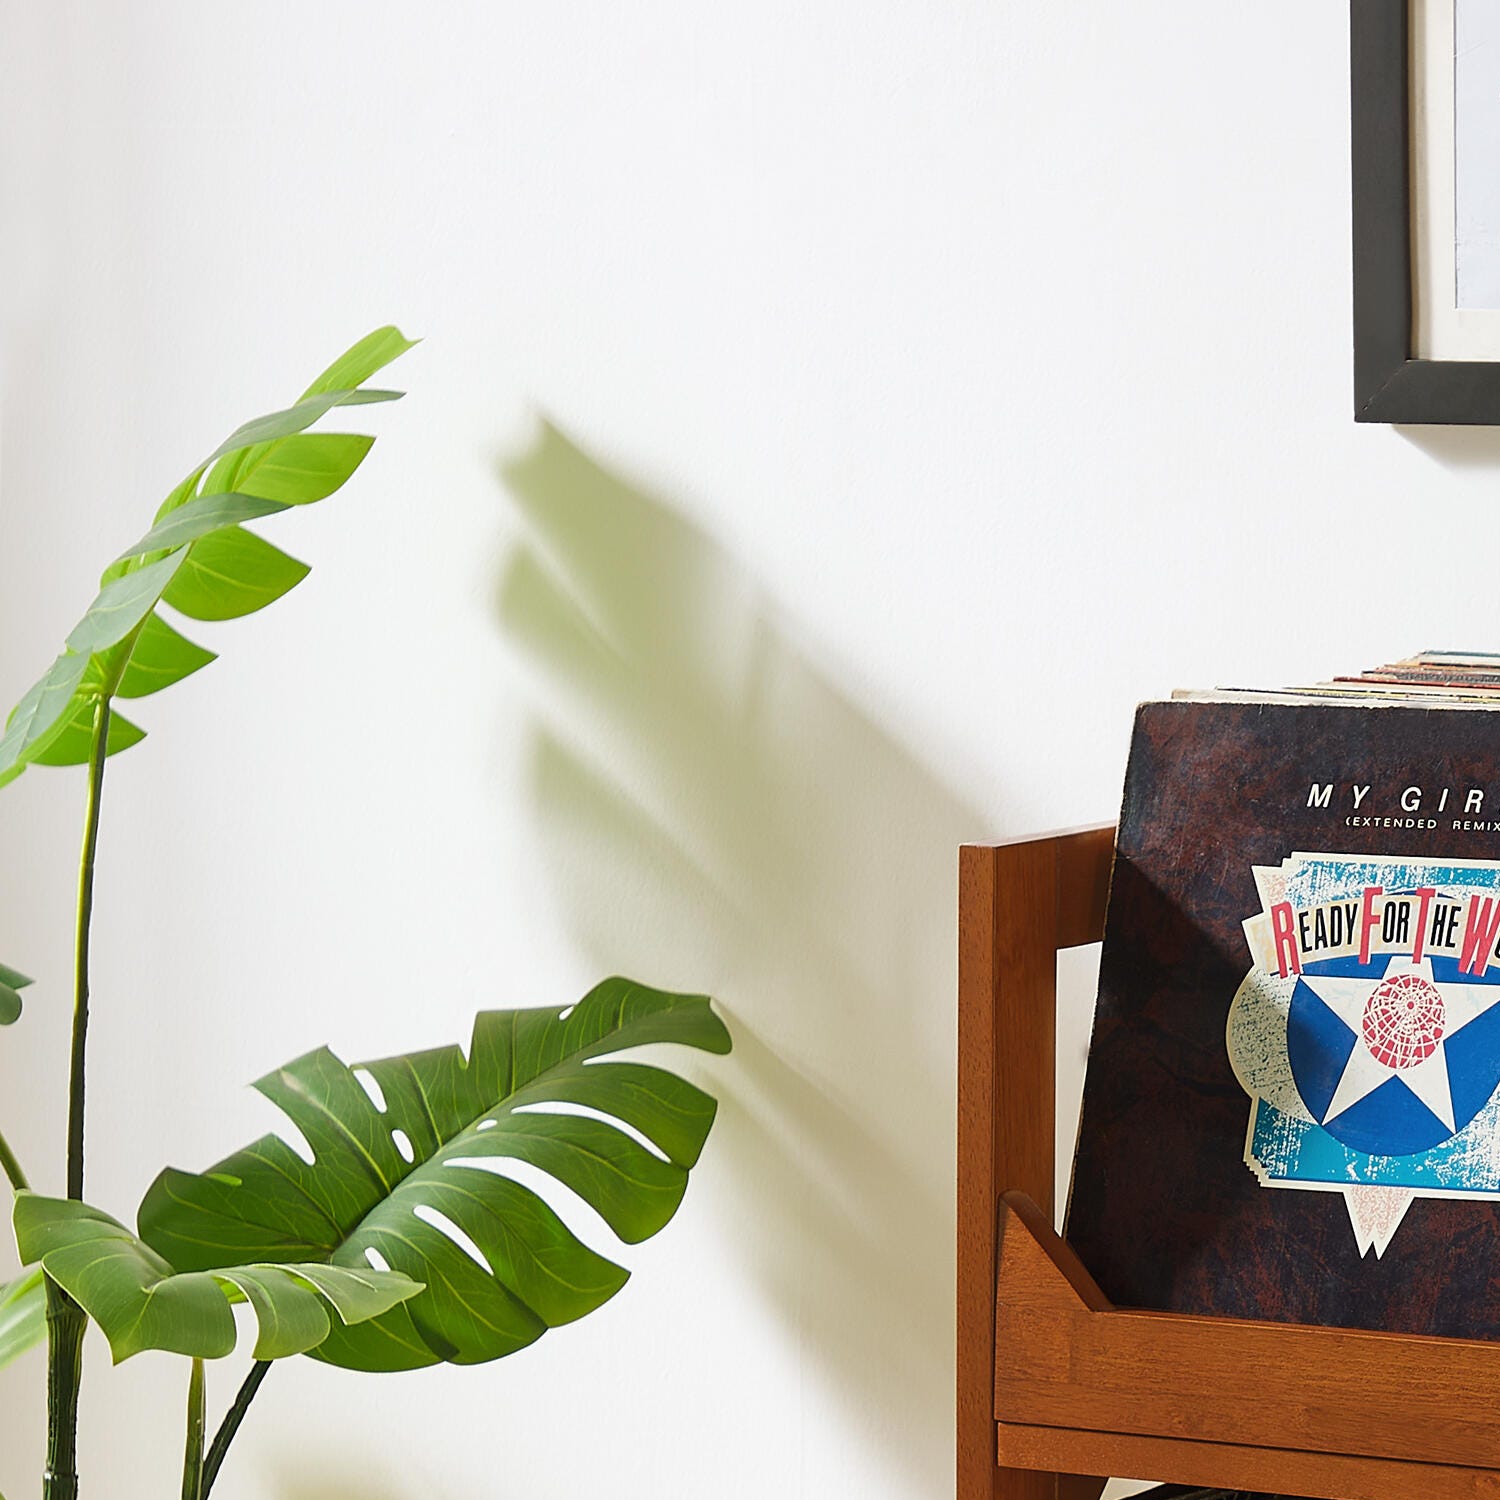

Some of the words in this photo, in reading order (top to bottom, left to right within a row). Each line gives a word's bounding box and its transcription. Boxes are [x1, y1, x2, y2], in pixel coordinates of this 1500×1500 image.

[1306, 783, 1371, 809] MY
[1344, 816, 1438, 830] (EXTENDED
[1270, 900, 1360, 980] READY
[1357, 887, 1411, 966] FOR
[1410, 888, 1463, 965] THE
